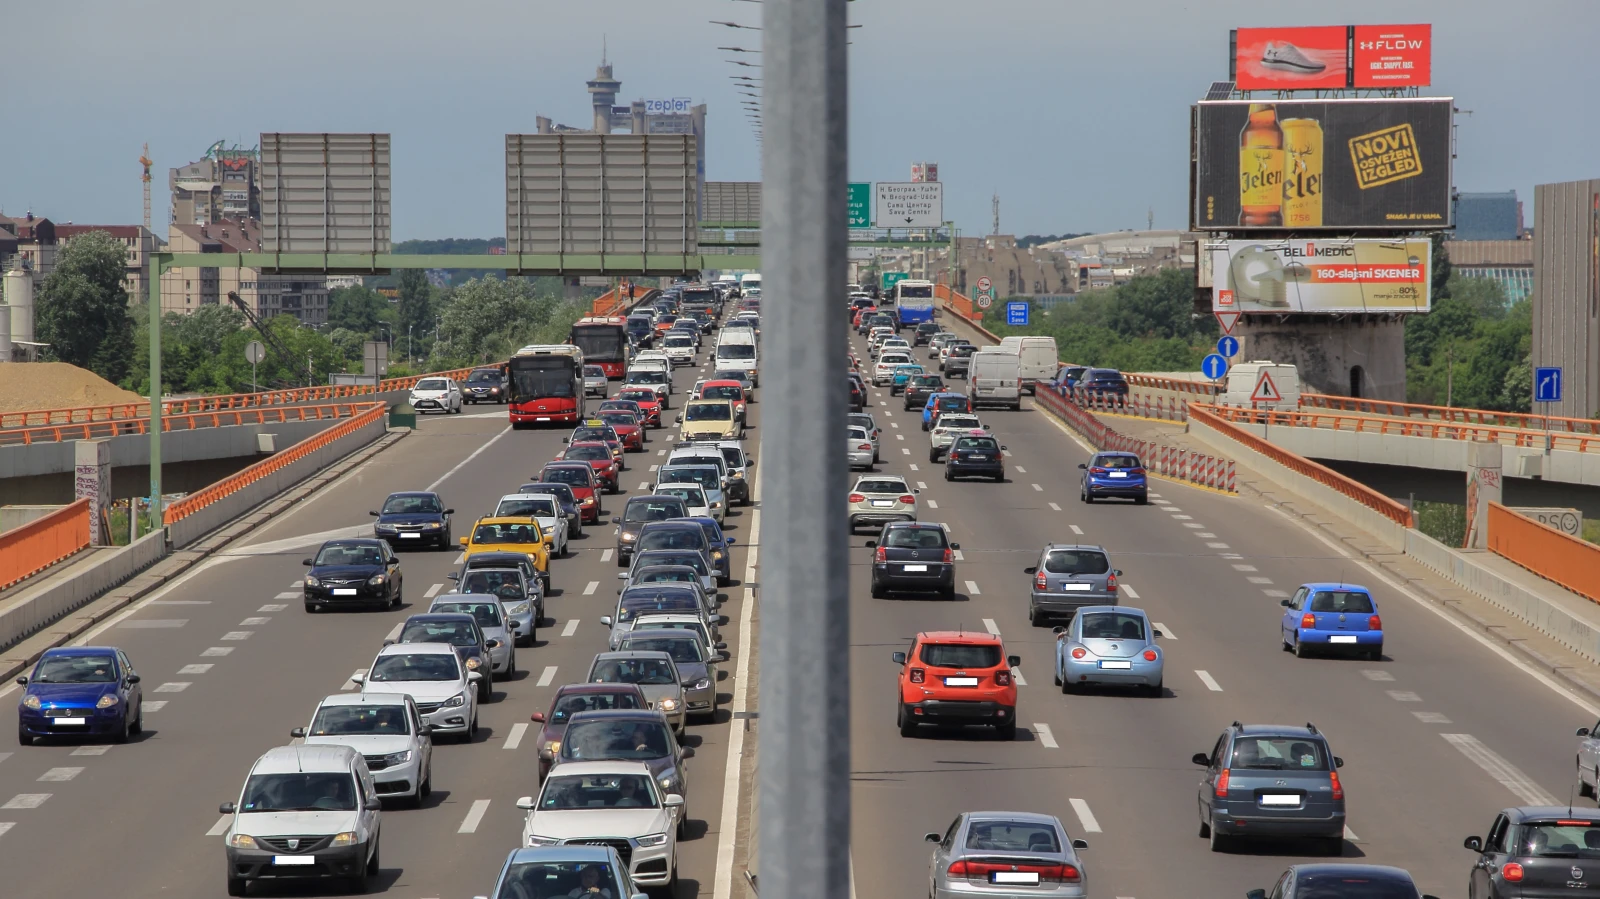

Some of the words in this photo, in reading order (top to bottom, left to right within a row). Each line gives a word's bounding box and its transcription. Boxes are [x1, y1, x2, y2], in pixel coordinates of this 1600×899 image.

[1376, 41, 1422, 50] FLOW
[646, 98, 691, 113] zepter
[1355, 130, 1409, 159] NOVI
[1359, 147, 1412, 169] OSVEŽEN
[1361, 158, 1416, 182] IZGLED
[1242, 170, 1282, 194] Jelen
[888, 208, 905, 216] Sava
[1284, 248, 1306, 257] BEL
[1317, 268, 1372, 281] 160-slajsni
[1374, 268, 1419, 279] SKENER
